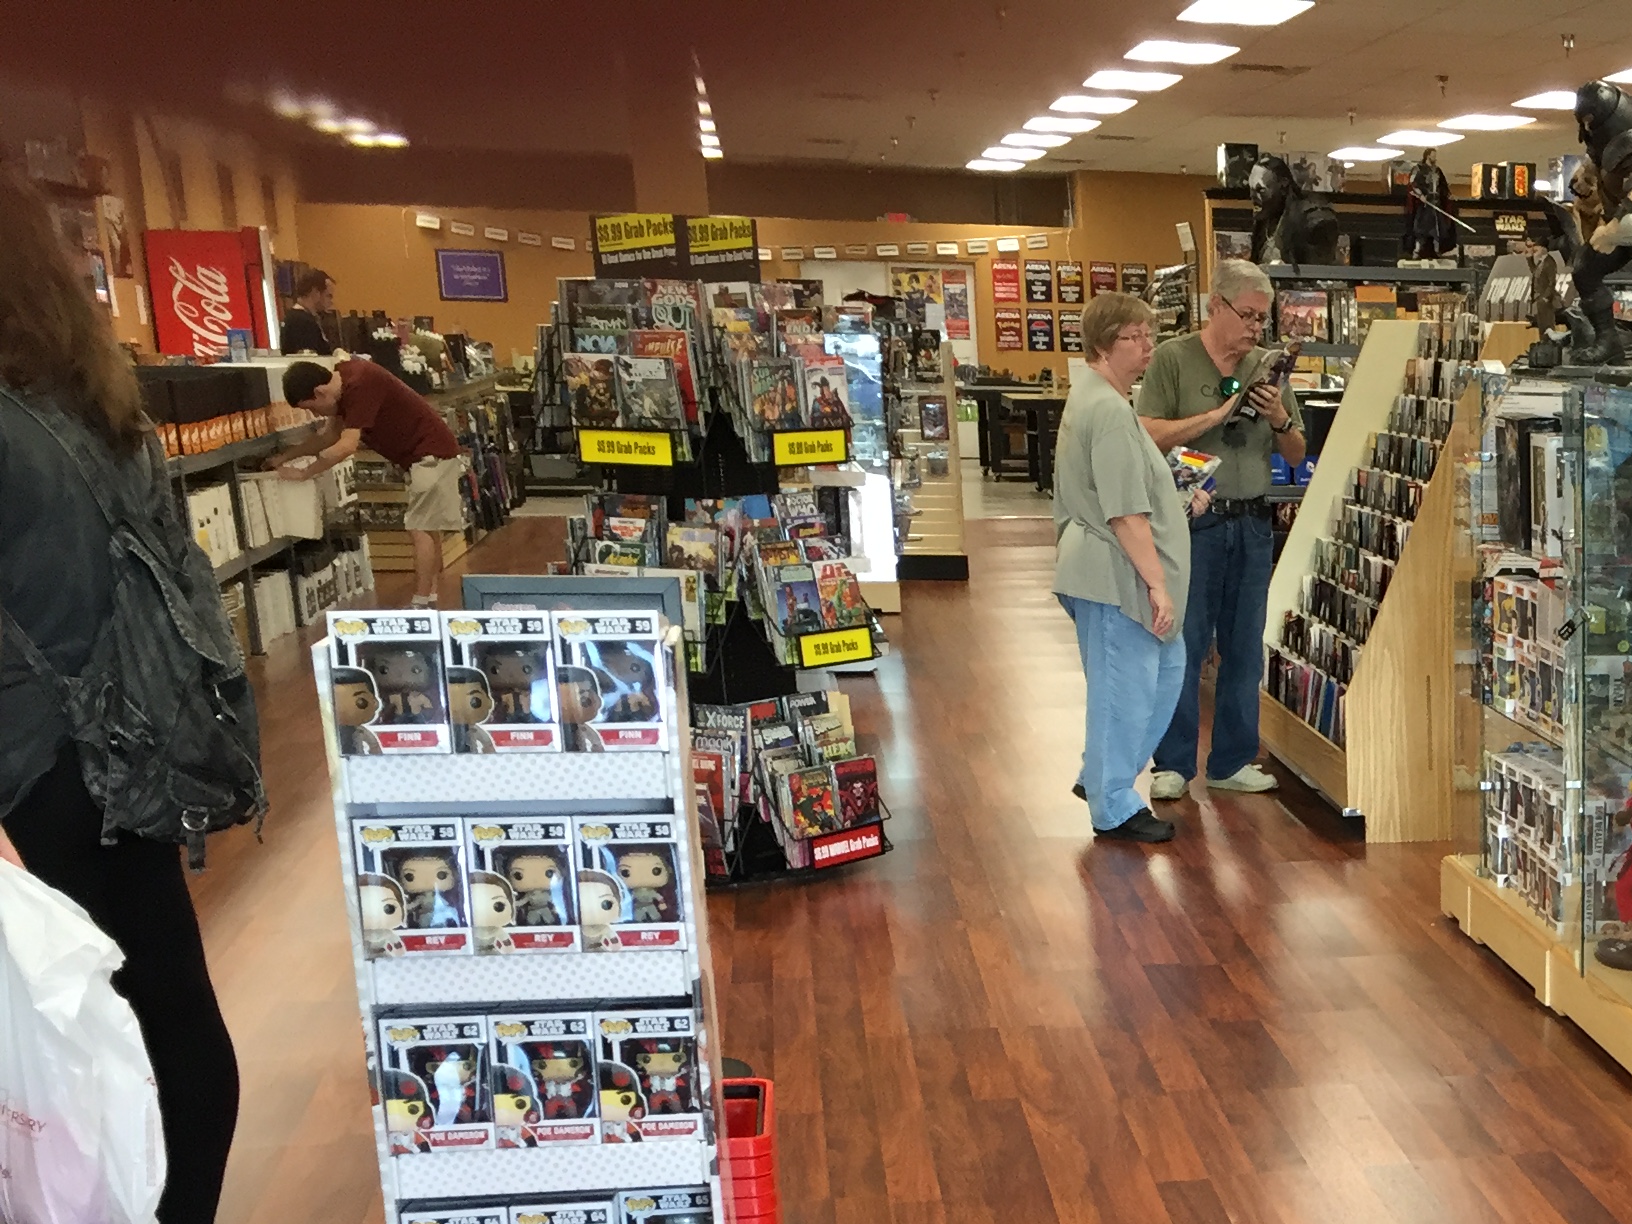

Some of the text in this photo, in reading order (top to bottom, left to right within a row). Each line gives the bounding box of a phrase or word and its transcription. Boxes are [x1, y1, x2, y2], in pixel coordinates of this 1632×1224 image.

[647, 218, 675, 236] Packs
[657, 284, 688, 295] NEW
[652, 294, 697, 308] GODS
[634, 442, 655, 455] Packs
[374, 618, 407, 626] STAR
[414, 620, 429, 631] 59
[489, 618, 520, 626] STAR
[527, 620, 542, 631] 59
[598, 618, 629, 626] STAR
[636, 620, 650, 632] 59
[371, 624, 409, 634] WARS
[486, 624, 523, 634] WARS
[595, 624, 632, 633] WARS
[717, 714, 745, 729] FORCE
[398, 732, 421, 741] FINN
[511, 731, 533, 740] FINN
[619, 730, 641, 739] FINN
[426, 936, 445, 945] REY
[534, 934, 553, 942] REY
[641, 932, 660, 940] REY
[571, 1022, 584, 1032] 62
[675, 1019, 689, 1030] 62
[463, 1026, 478, 1036] 62
